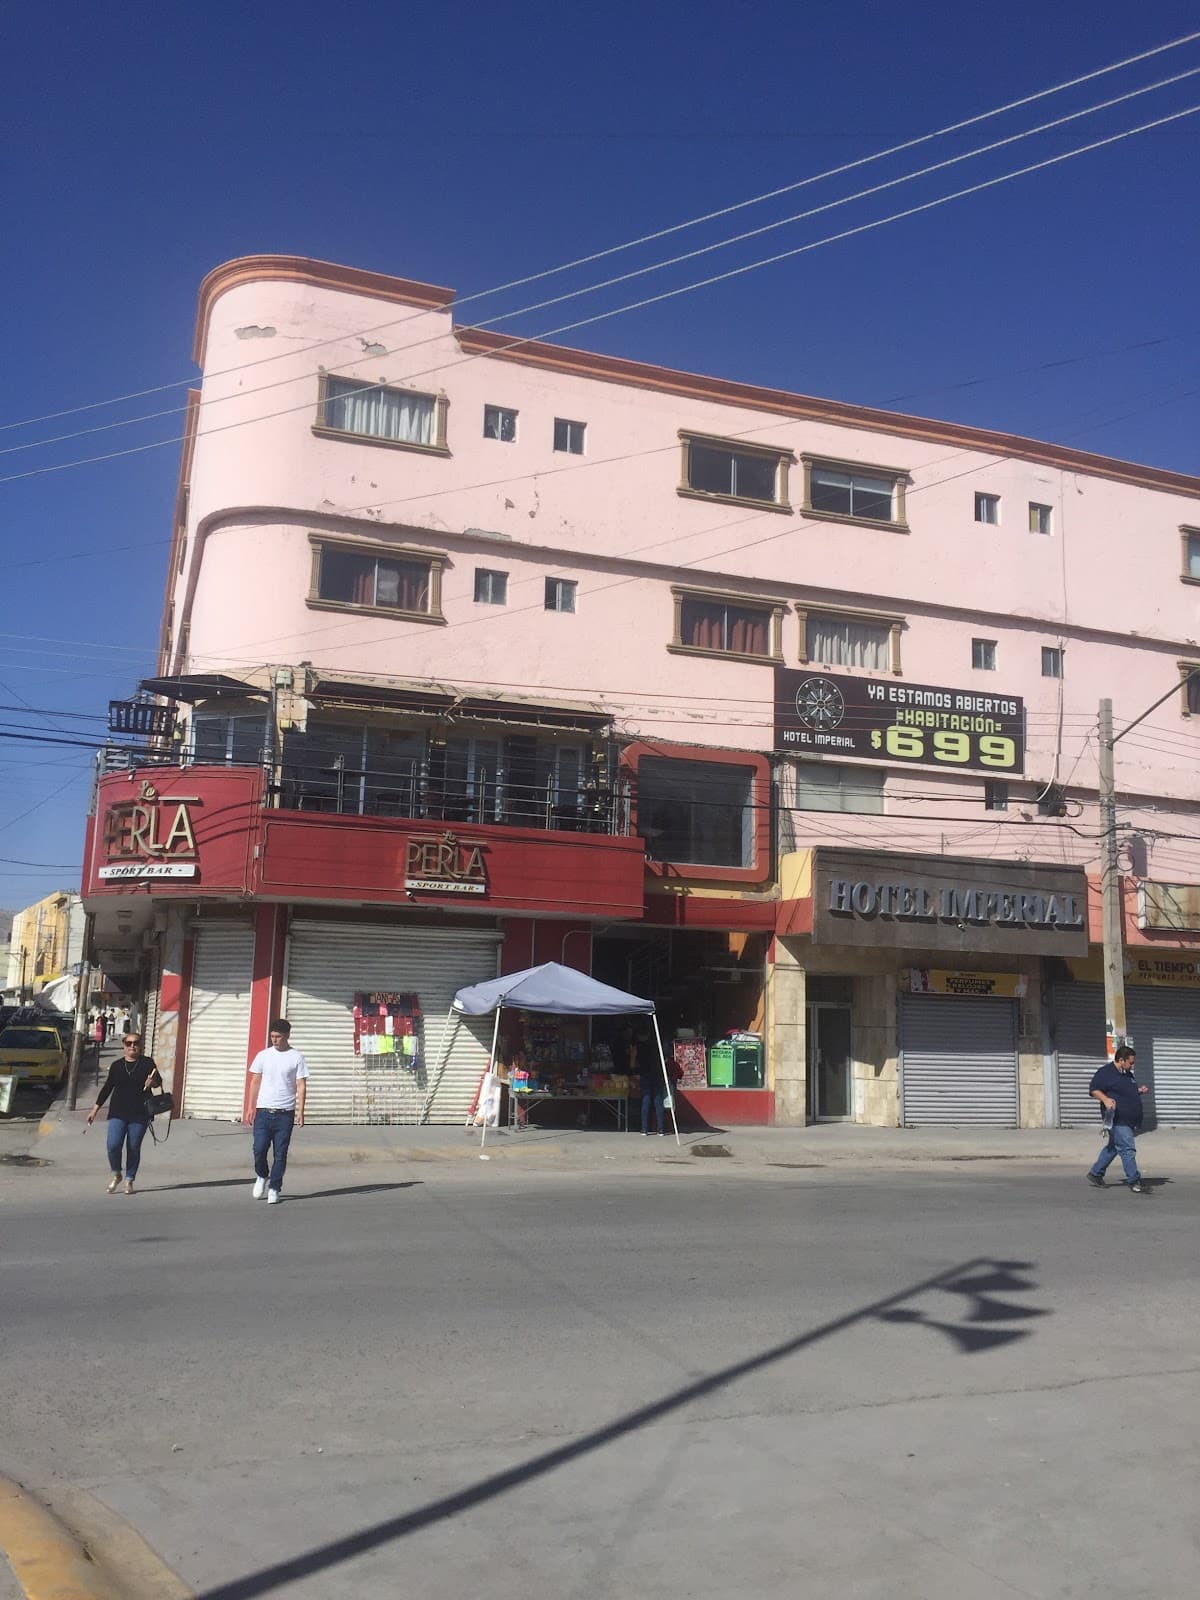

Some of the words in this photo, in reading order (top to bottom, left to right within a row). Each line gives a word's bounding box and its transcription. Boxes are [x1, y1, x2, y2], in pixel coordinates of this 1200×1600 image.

[867, 684, 885, 700] YA
[889, 687, 952, 708] ESTAMOS
[956, 694, 1017, 716] ABIERTOS
[783, 731, 812, 744] HOTEL
[814, 733, 856, 748] IMPERIAL
[103, 803, 195, 857] PERLA
[109, 867, 145, 877] SPORT
[146, 866, 173, 875] BAR
[405, 842, 486, 879] PERLA
[415, 882, 451, 890] SPORT
[828, 879, 935, 917] HOTEL
[938, 887, 1085, 926] IMPERIAL
[1138, 959, 1152, 971] EL
[1154, 960, 1195, 974] TIEMPO
